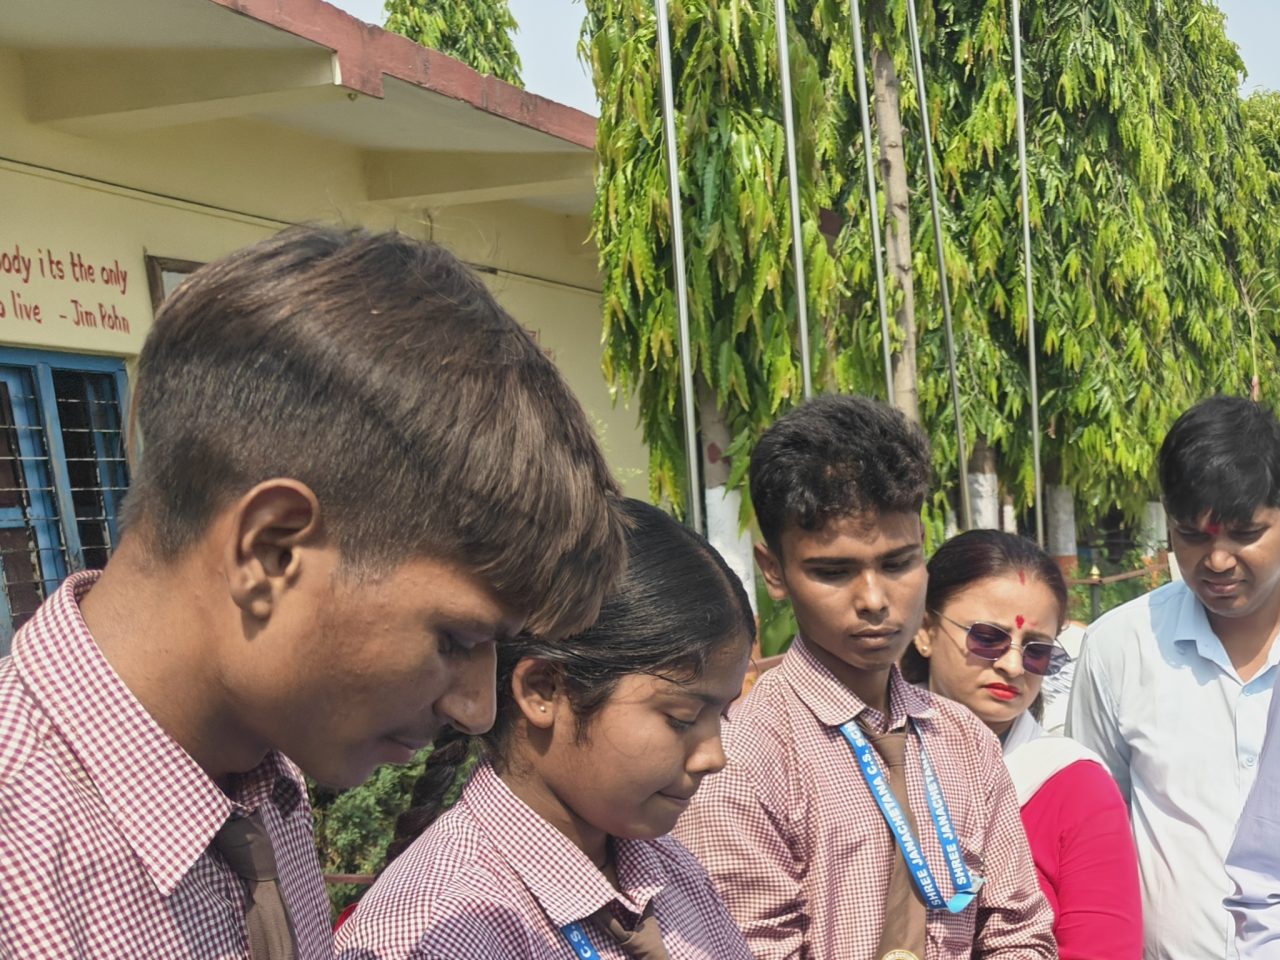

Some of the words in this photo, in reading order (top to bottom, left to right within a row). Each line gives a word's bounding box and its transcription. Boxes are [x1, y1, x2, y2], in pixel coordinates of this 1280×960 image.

[0, 244, 31, 284] ody
[69, 251, 95, 284] the
[100, 259, 128, 295] only
[10, 289, 42, 324] live
[70, 299, 98, 328] Jim
[98, 302, 130, 334] Rohn
[872, 776, 924, 867] JANACHETANA
[916, 868, 942, 906] SHREE
[946, 843, 967, 886] SHREE
